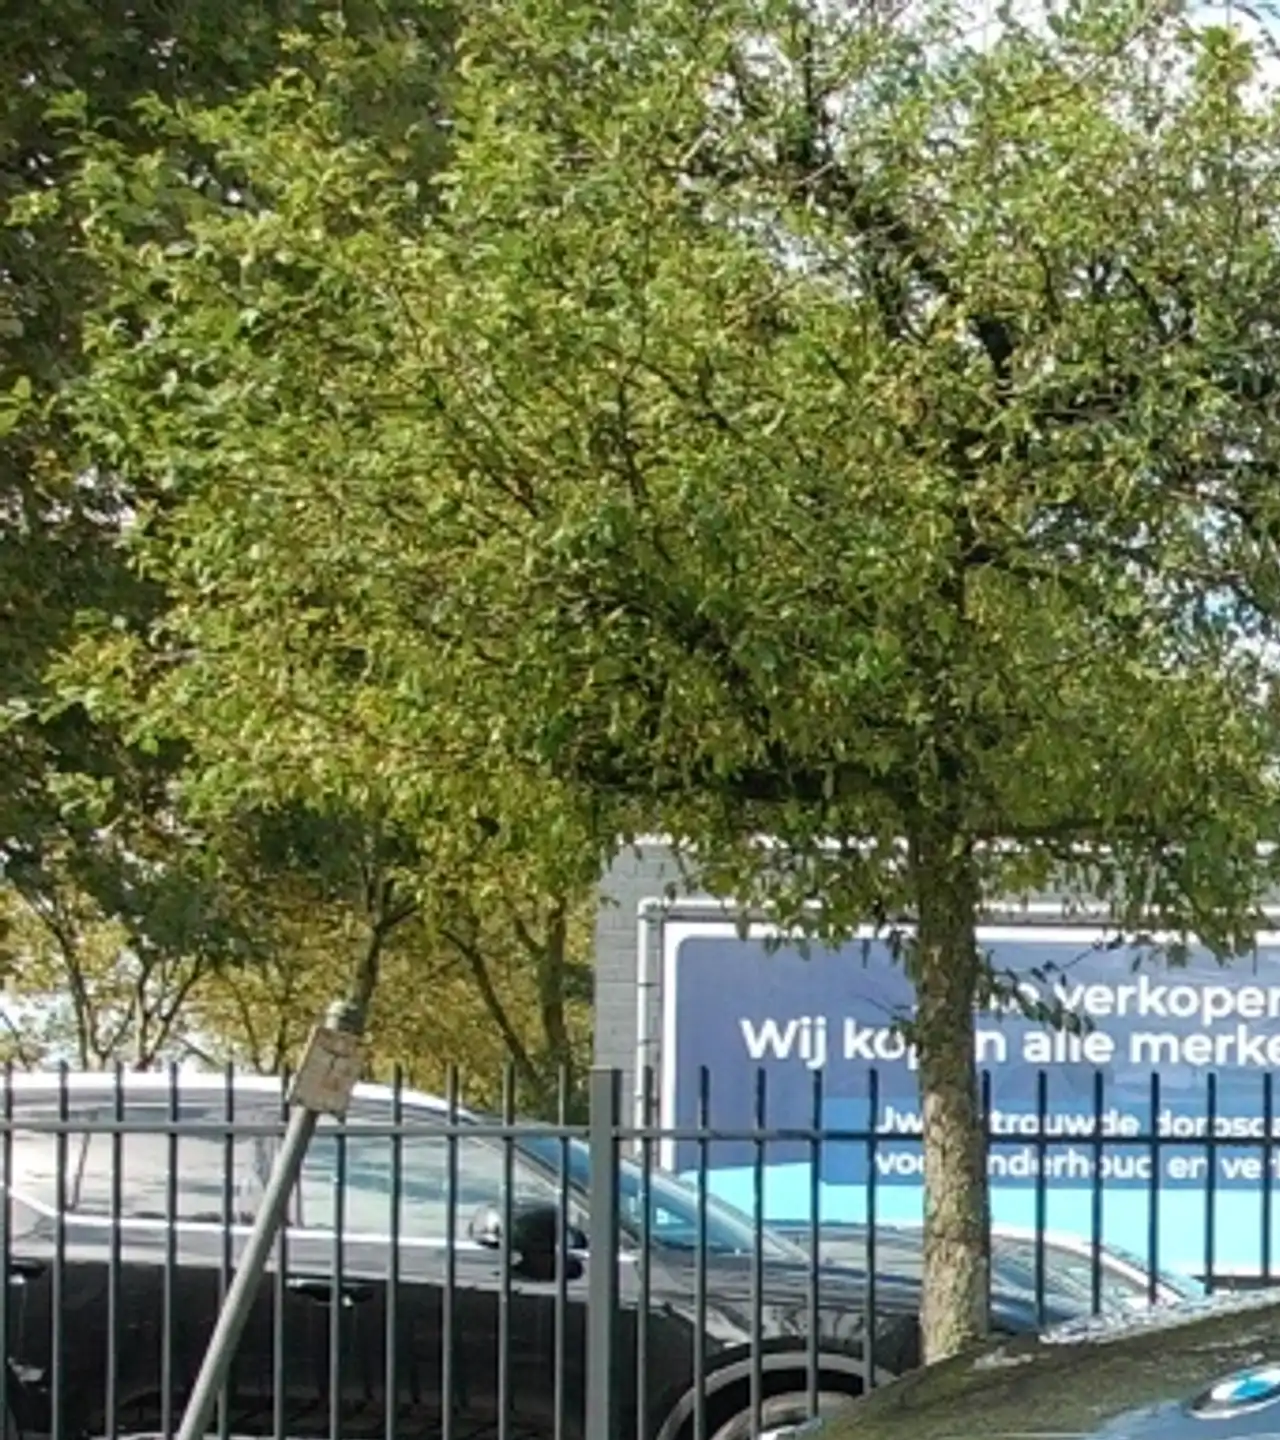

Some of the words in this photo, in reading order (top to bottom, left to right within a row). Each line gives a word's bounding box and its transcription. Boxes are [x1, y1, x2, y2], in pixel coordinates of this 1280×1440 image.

[740, 1015, 827, 1070] Wij
[843, 1016, 1007, 1071] kon
[1023, 1022, 1115, 1064] alle
